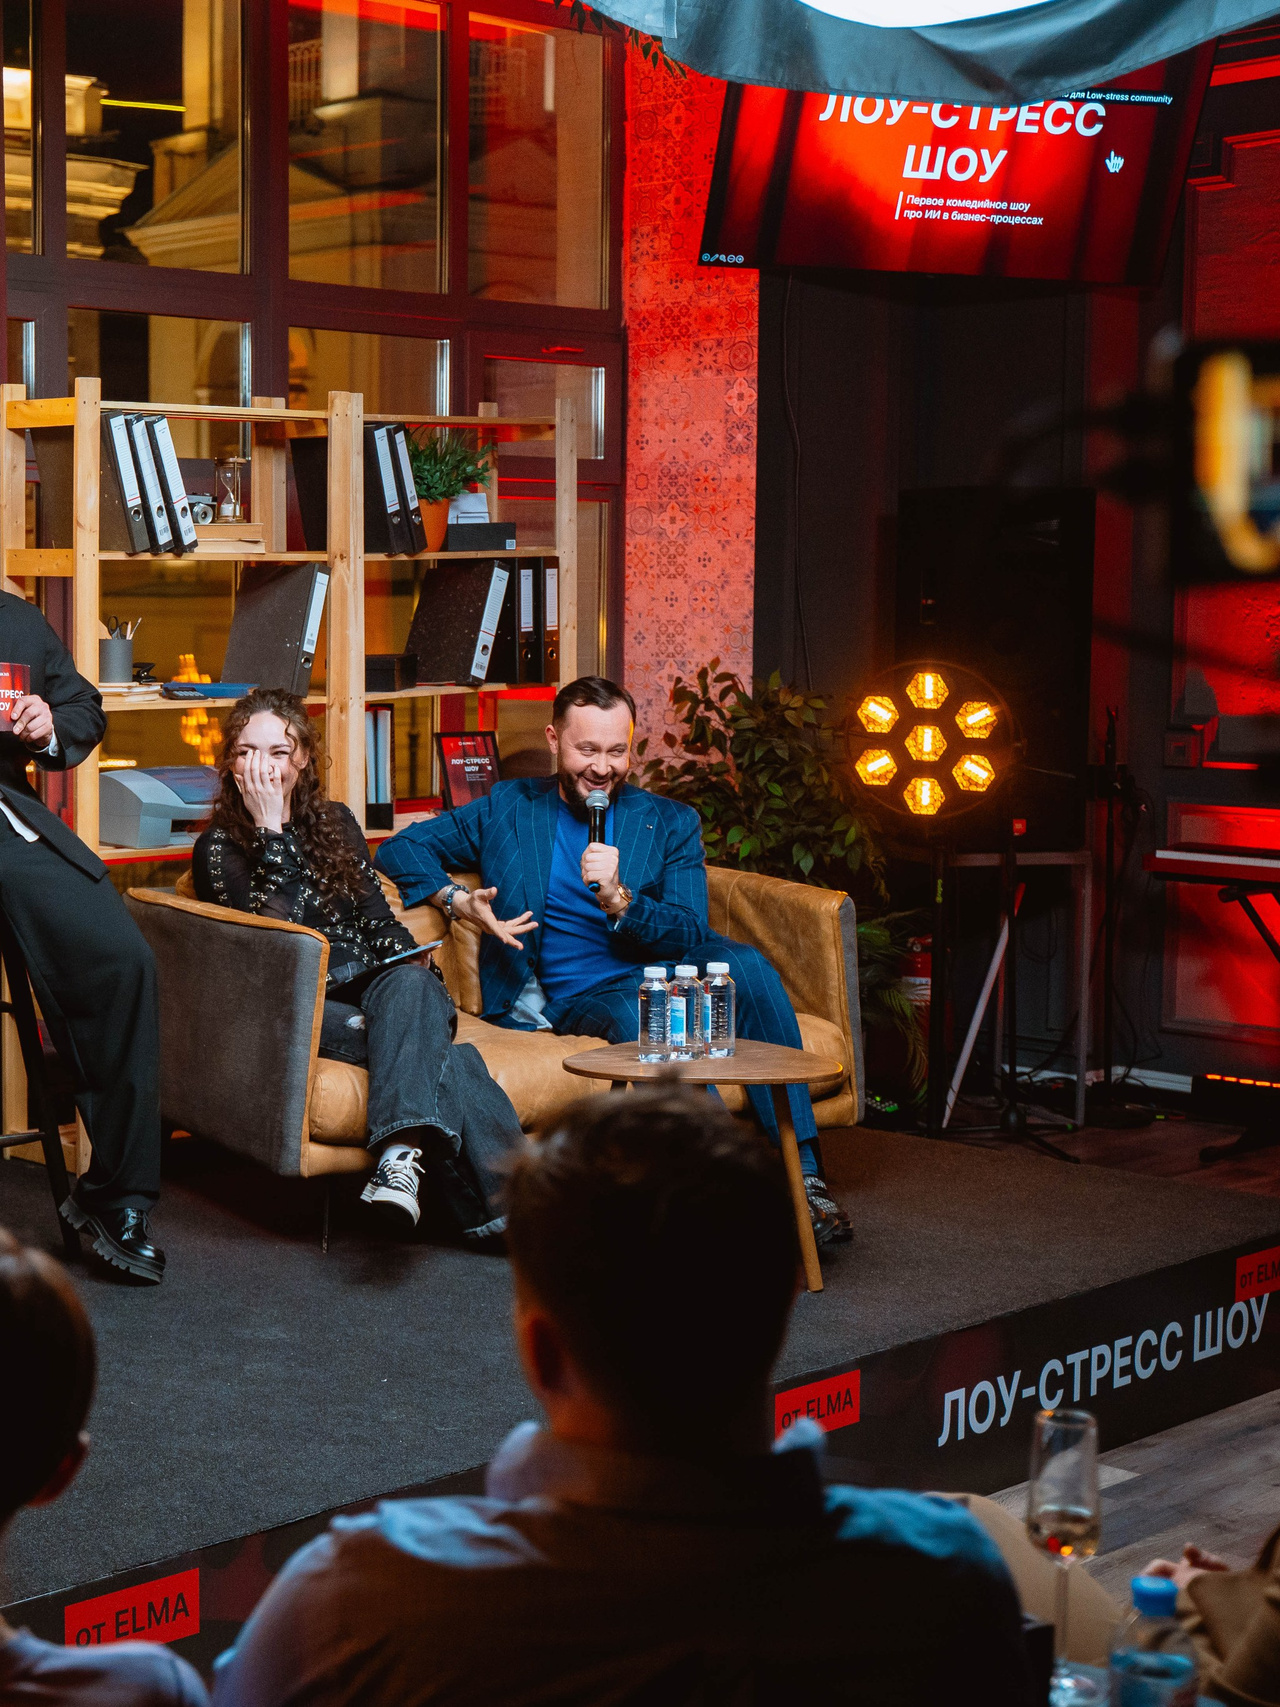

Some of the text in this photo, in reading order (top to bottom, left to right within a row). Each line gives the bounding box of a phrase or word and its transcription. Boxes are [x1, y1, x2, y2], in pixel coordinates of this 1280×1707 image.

[1086, 91, 1129, 101] Low-stress
[1130, 94, 1173, 105] community
[819, 94, 1106, 137] ЛОУ-СТРЕСС
[902, 145, 1008, 183] ШОУ
[903, 209, 1044, 225] про ИИ в бизнес-процессах
[906, 194, 1031, 213] Первое комедийное шоу
[1257, 1260, 1280, 1284] ELM
[937, 1292, 1270, 1448] ЛОУ-СТРЕСС ШОУ
[806, 1387, 854, 1420] ELMA
[115, 1592, 190, 1639] ELMA
